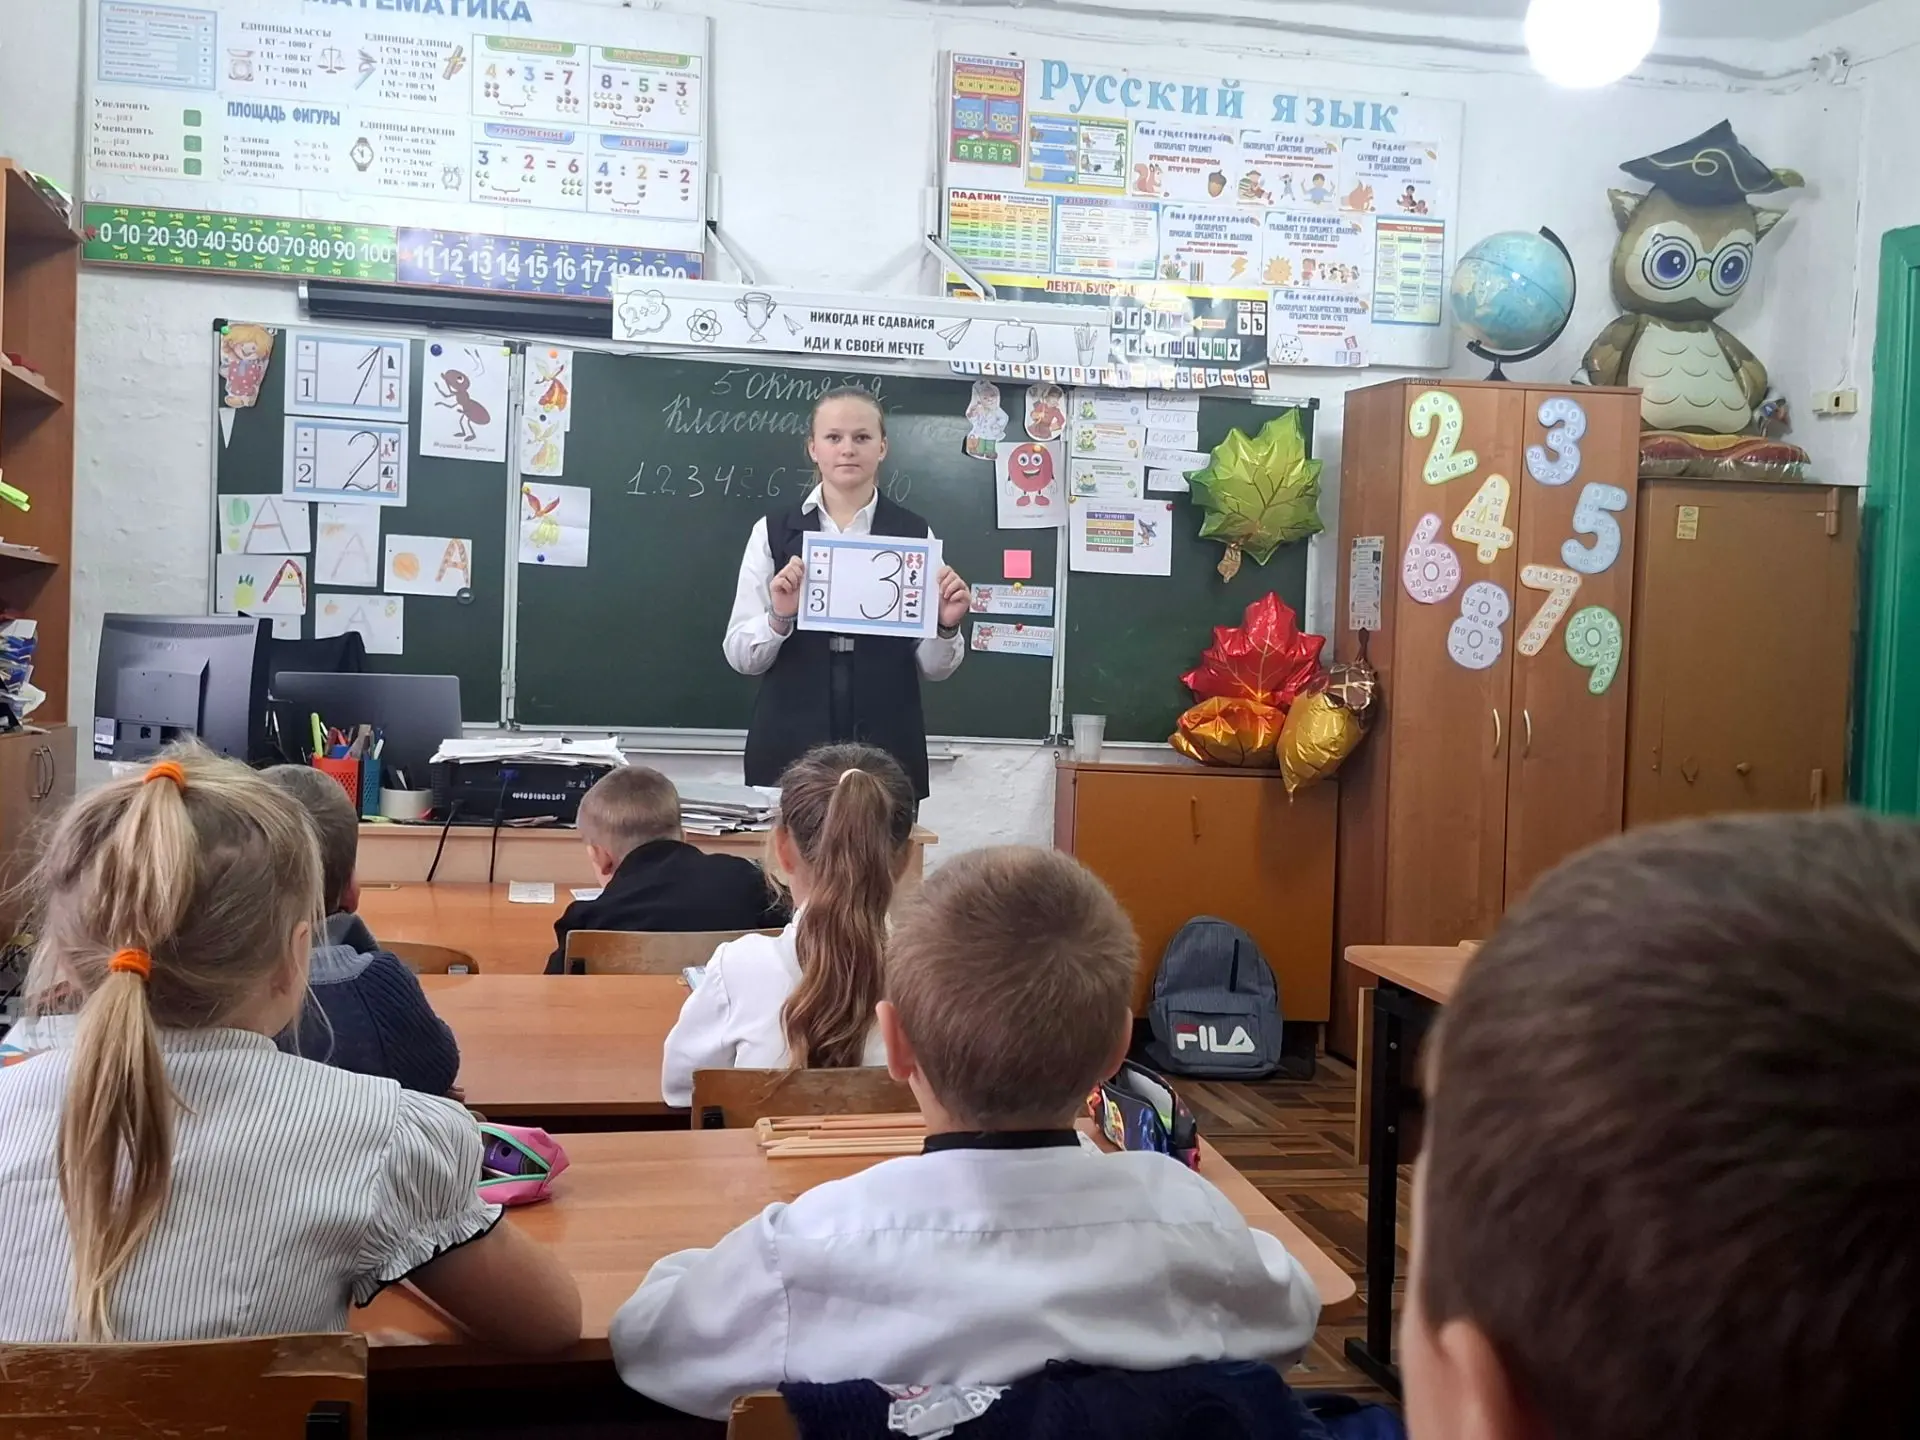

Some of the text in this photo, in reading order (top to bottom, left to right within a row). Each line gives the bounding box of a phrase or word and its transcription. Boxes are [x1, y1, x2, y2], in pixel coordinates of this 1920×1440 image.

[303, 0, 532, 22] МАТИКА
[294, 27, 332, 37] МАССЫ
[485, 64, 573, 85] 4 3 7
[601, 74, 687, 97] 8 5 3
[1040, 58, 1399, 133] Русский язык
[95, 98, 150, 111] Увеличить
[227, 101, 340, 126] ПЛОЩАДЬ ФИГУРЫ
[94, 122, 154, 135] Уменьшить
[478, 150, 579, 174] 3 2 6
[598, 161, 690, 184] 4 2 2
[952, 191, 1001, 201] ПАДЕЖИ
[100, 223, 390, 263] 0 10 20 30 40 50 60 70 80 90 100
[413, 245, 434, 270] 11
[439, 247, 464, 272] 12
[468, 250, 492, 274] 13
[496, 252, 520, 277] 14
[525, 255, 548, 278] 15
[553, 257, 576, 281] 16
[580, 259, 604, 283] 17
[1046, 280, 1083, 292] ЛЕНТА
[810, 311, 935, 330] НИКОГДА НЕ СДАВАЙСЯ
[1131, 312, 1138, 324] Г
[804, 336, 925, 355] ИДИ К СВОЕЙ МЕЧТЕ
[1171, 341, 1182, 354] Ш
[1187, 342, 1196, 357] Ц
[1201, 342, 1210, 356] Ч
[1214, 343, 1226, 359] Щ
[1229, 344, 1239, 357] Х
[357, 345, 381, 406] 1
[1059, 366, 1066, 377] 7
[1090, 368, 1096, 379] 9
[1177, 372, 1189, 384] 15
[1192, 374, 1203, 384] 16
[1207, 374, 1218, 384] 17
[1238, 374, 1250, 384] 19
[1253, 374, 1266, 384] 20
[301, 378, 312, 398] 1
[1446, 421, 1457, 429] 10
[342, 431, 379, 491] 2
[1463, 457, 1474, 467] 20
[298, 463, 312, 484] 2
[688, 465, 704, 498] 3
[714, 465, 735, 496] 4
[767, 467, 786, 496] 6
[1416, 532, 1427, 540] 12
[860, 550, 903, 620] 3
[810, 588, 825, 612] 3
[1175, 1023, 1256, 1053] FILA
